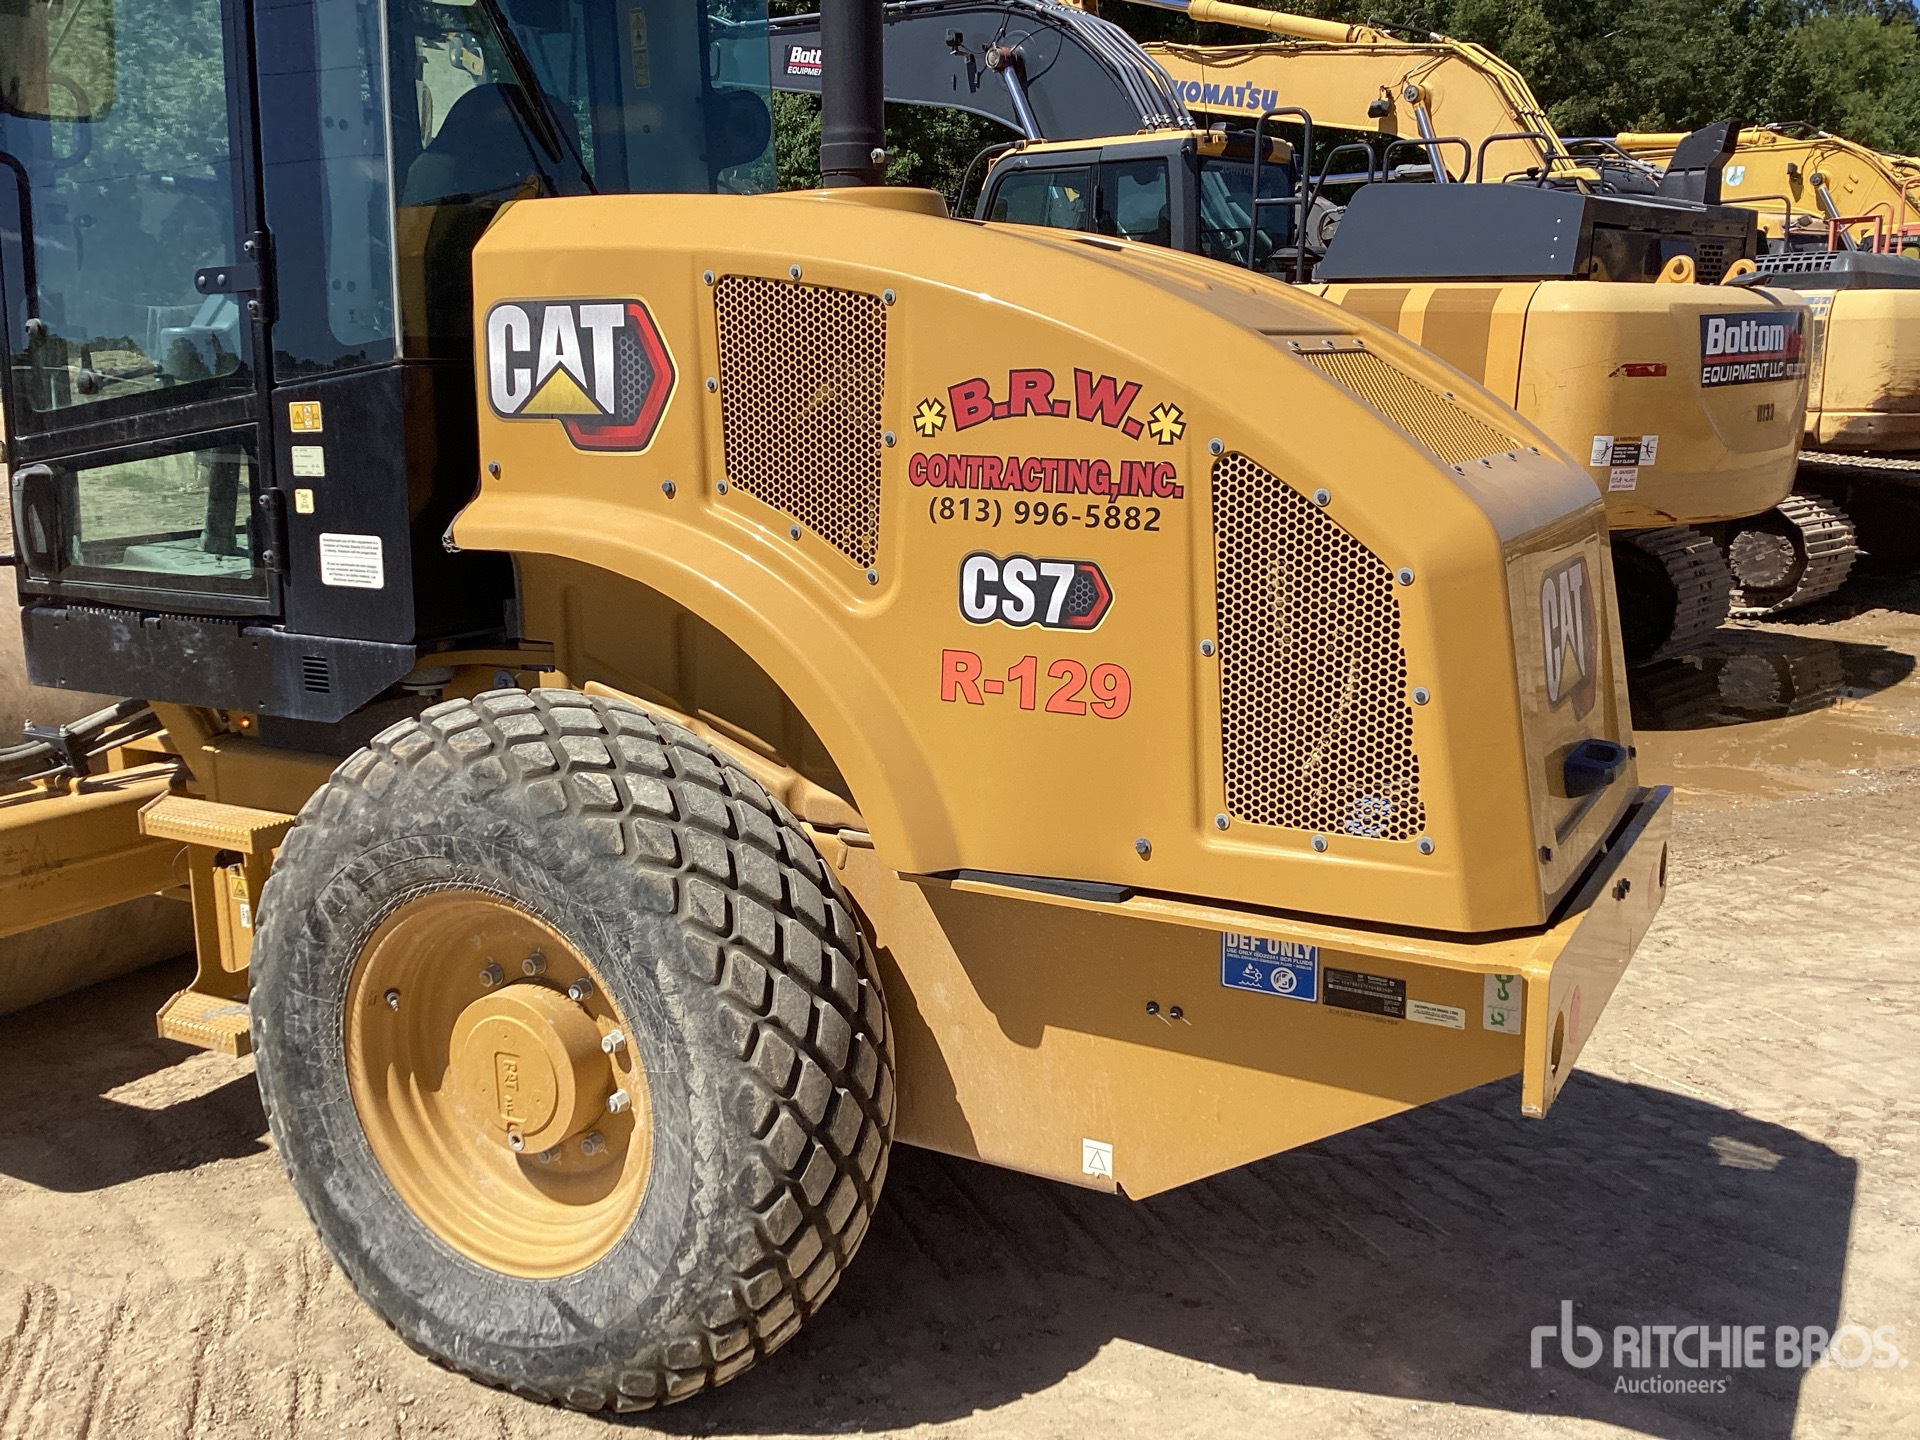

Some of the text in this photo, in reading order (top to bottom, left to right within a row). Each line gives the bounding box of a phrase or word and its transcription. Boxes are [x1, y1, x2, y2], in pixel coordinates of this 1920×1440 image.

[1172, 80, 1278, 112] KOMATSU
[488, 304, 625, 414] CAT
[1705, 318, 1784, 355] Bottom
[1702, 362, 1768, 384] EQUIPMENT
[1769, 361, 1784, 378] LLC
[947, 367, 1145, 441] B.R.W.
[908, 453, 1185, 504] CONTRACTING,INC.
[929, 497, 1161, 532] (813) 996-5882
[962, 555, 1075, 624] CS7
[1542, 562, 1586, 702] CAT
[941, 648, 1132, 720] R-129
[1227, 932, 1313, 960] DEF ONLY
